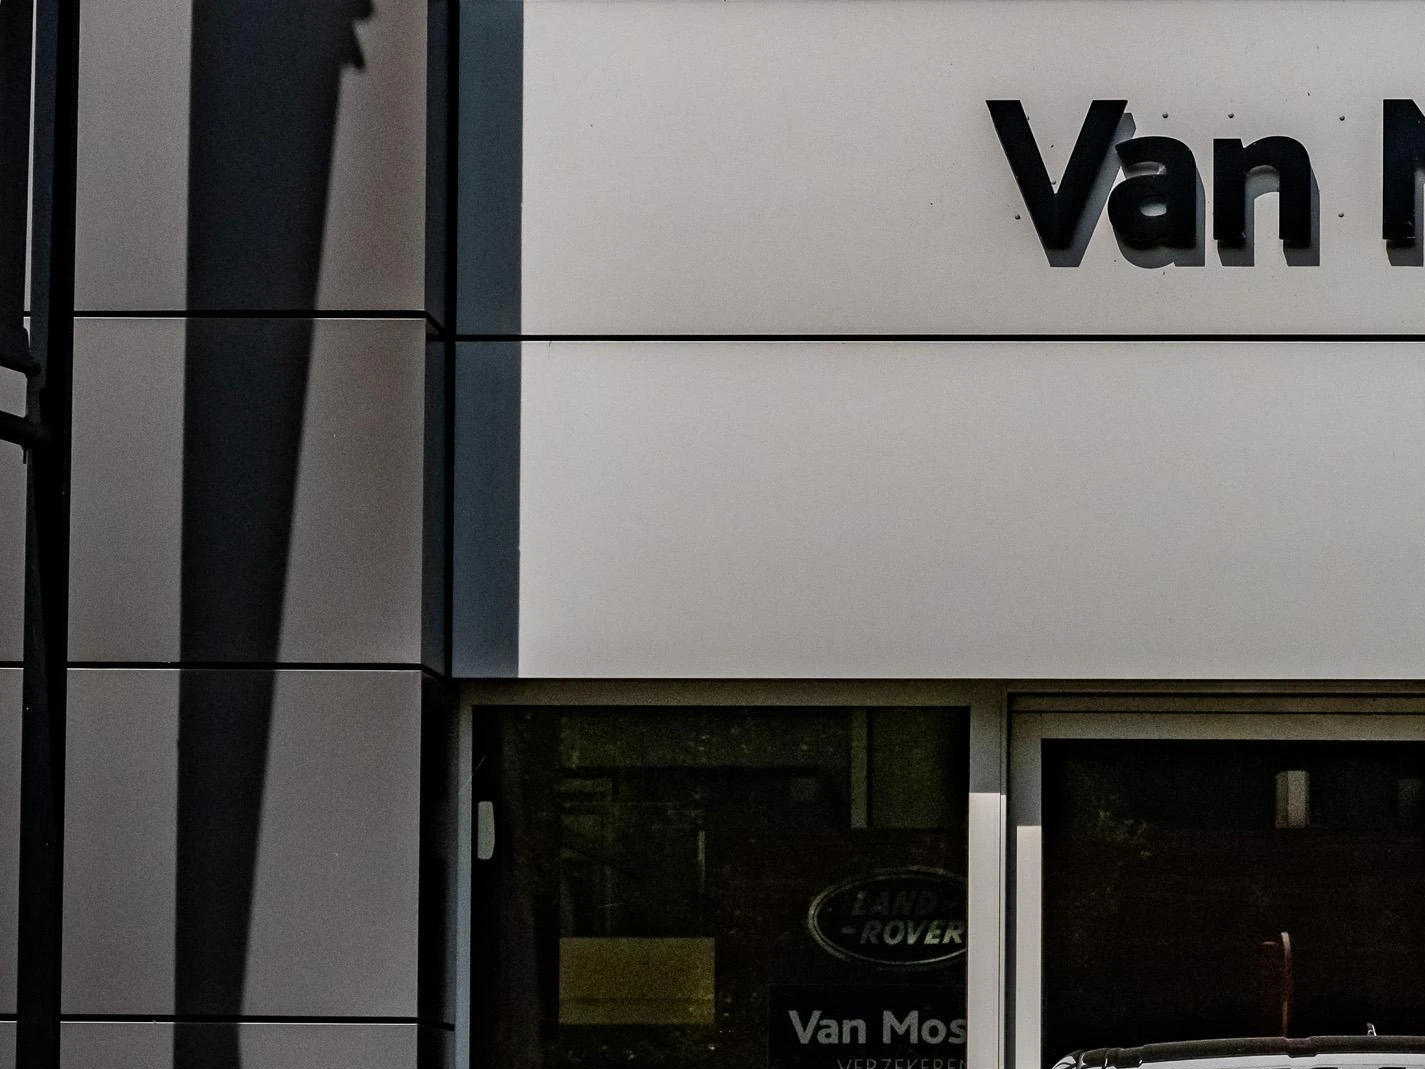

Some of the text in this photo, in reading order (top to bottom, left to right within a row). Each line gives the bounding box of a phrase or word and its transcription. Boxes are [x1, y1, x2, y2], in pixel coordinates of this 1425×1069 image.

[985, 98, 1315, 250] Van
[851, 889, 939, 917] LAND
[859, 919, 966, 946] ROVER
[788, 1010, 867, 1044] Van
